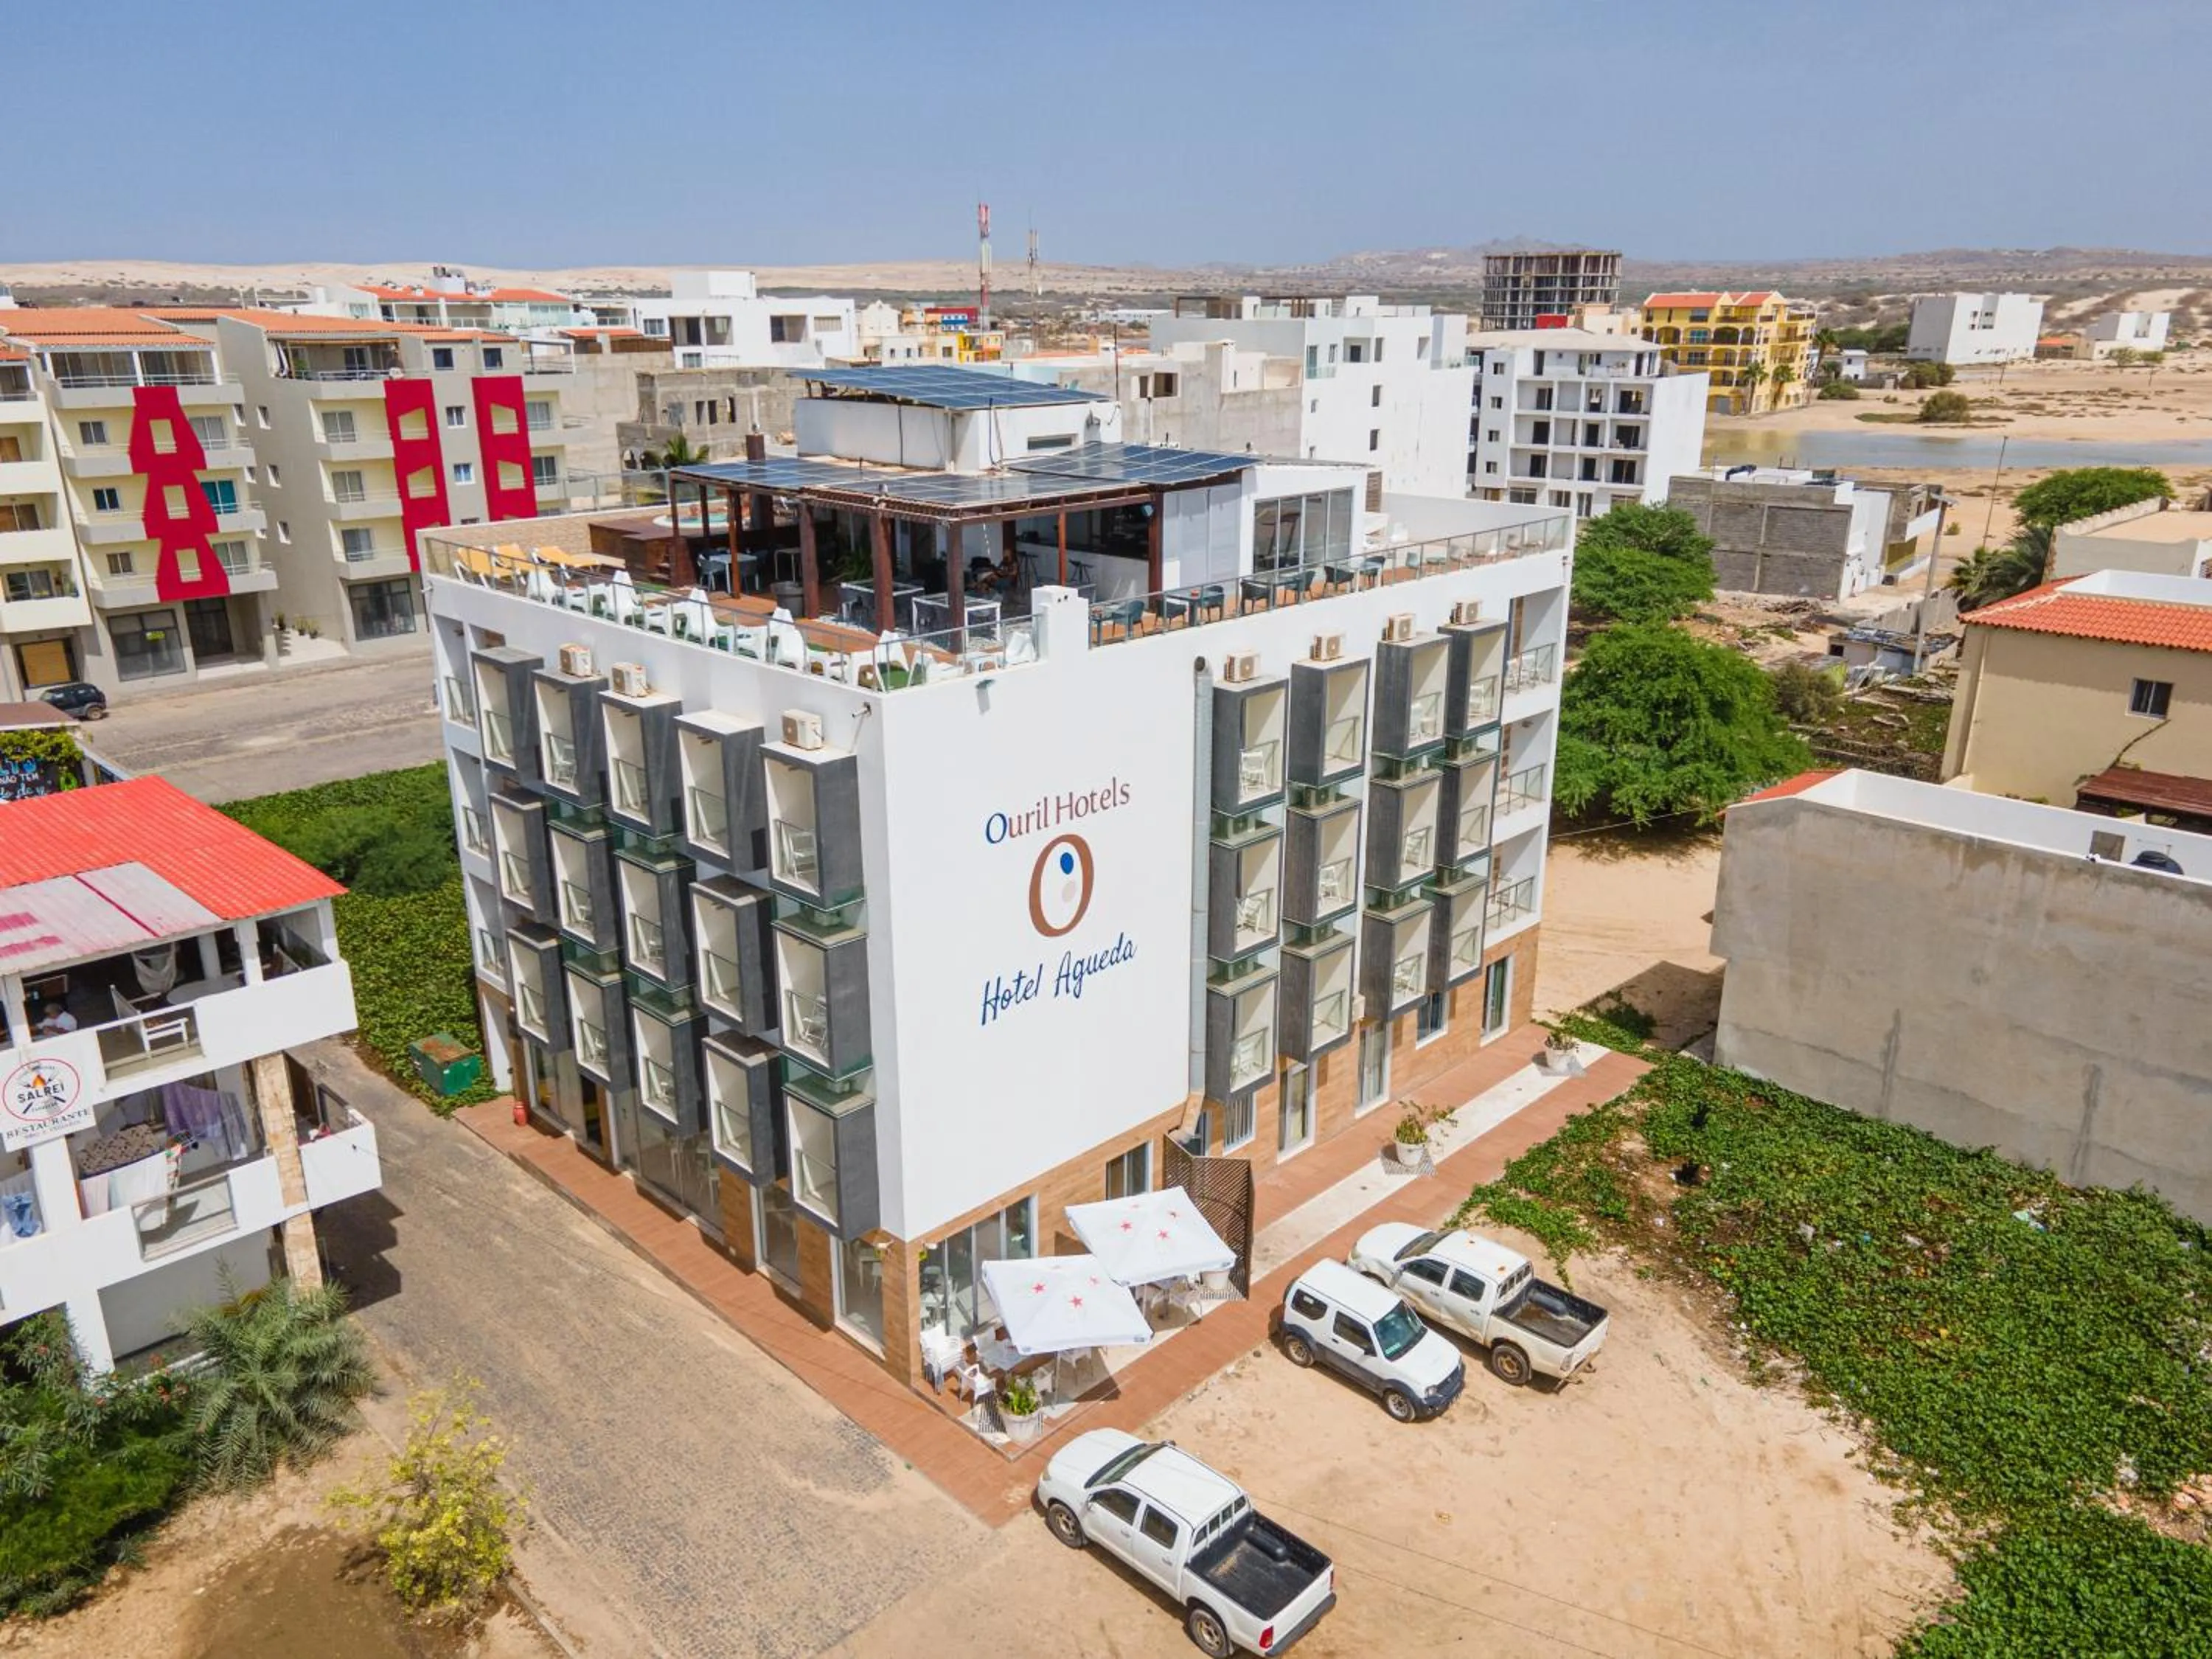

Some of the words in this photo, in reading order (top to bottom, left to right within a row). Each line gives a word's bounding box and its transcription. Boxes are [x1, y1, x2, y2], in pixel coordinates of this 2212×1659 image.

[985, 797, 1048, 844] Ouril
[1055, 776, 1131, 824] Hotels
[981, 964, 1043, 1026] Hotel
[1054, 931, 1138, 999] Agueda
[17, 1082, 65, 1104] SALREI
